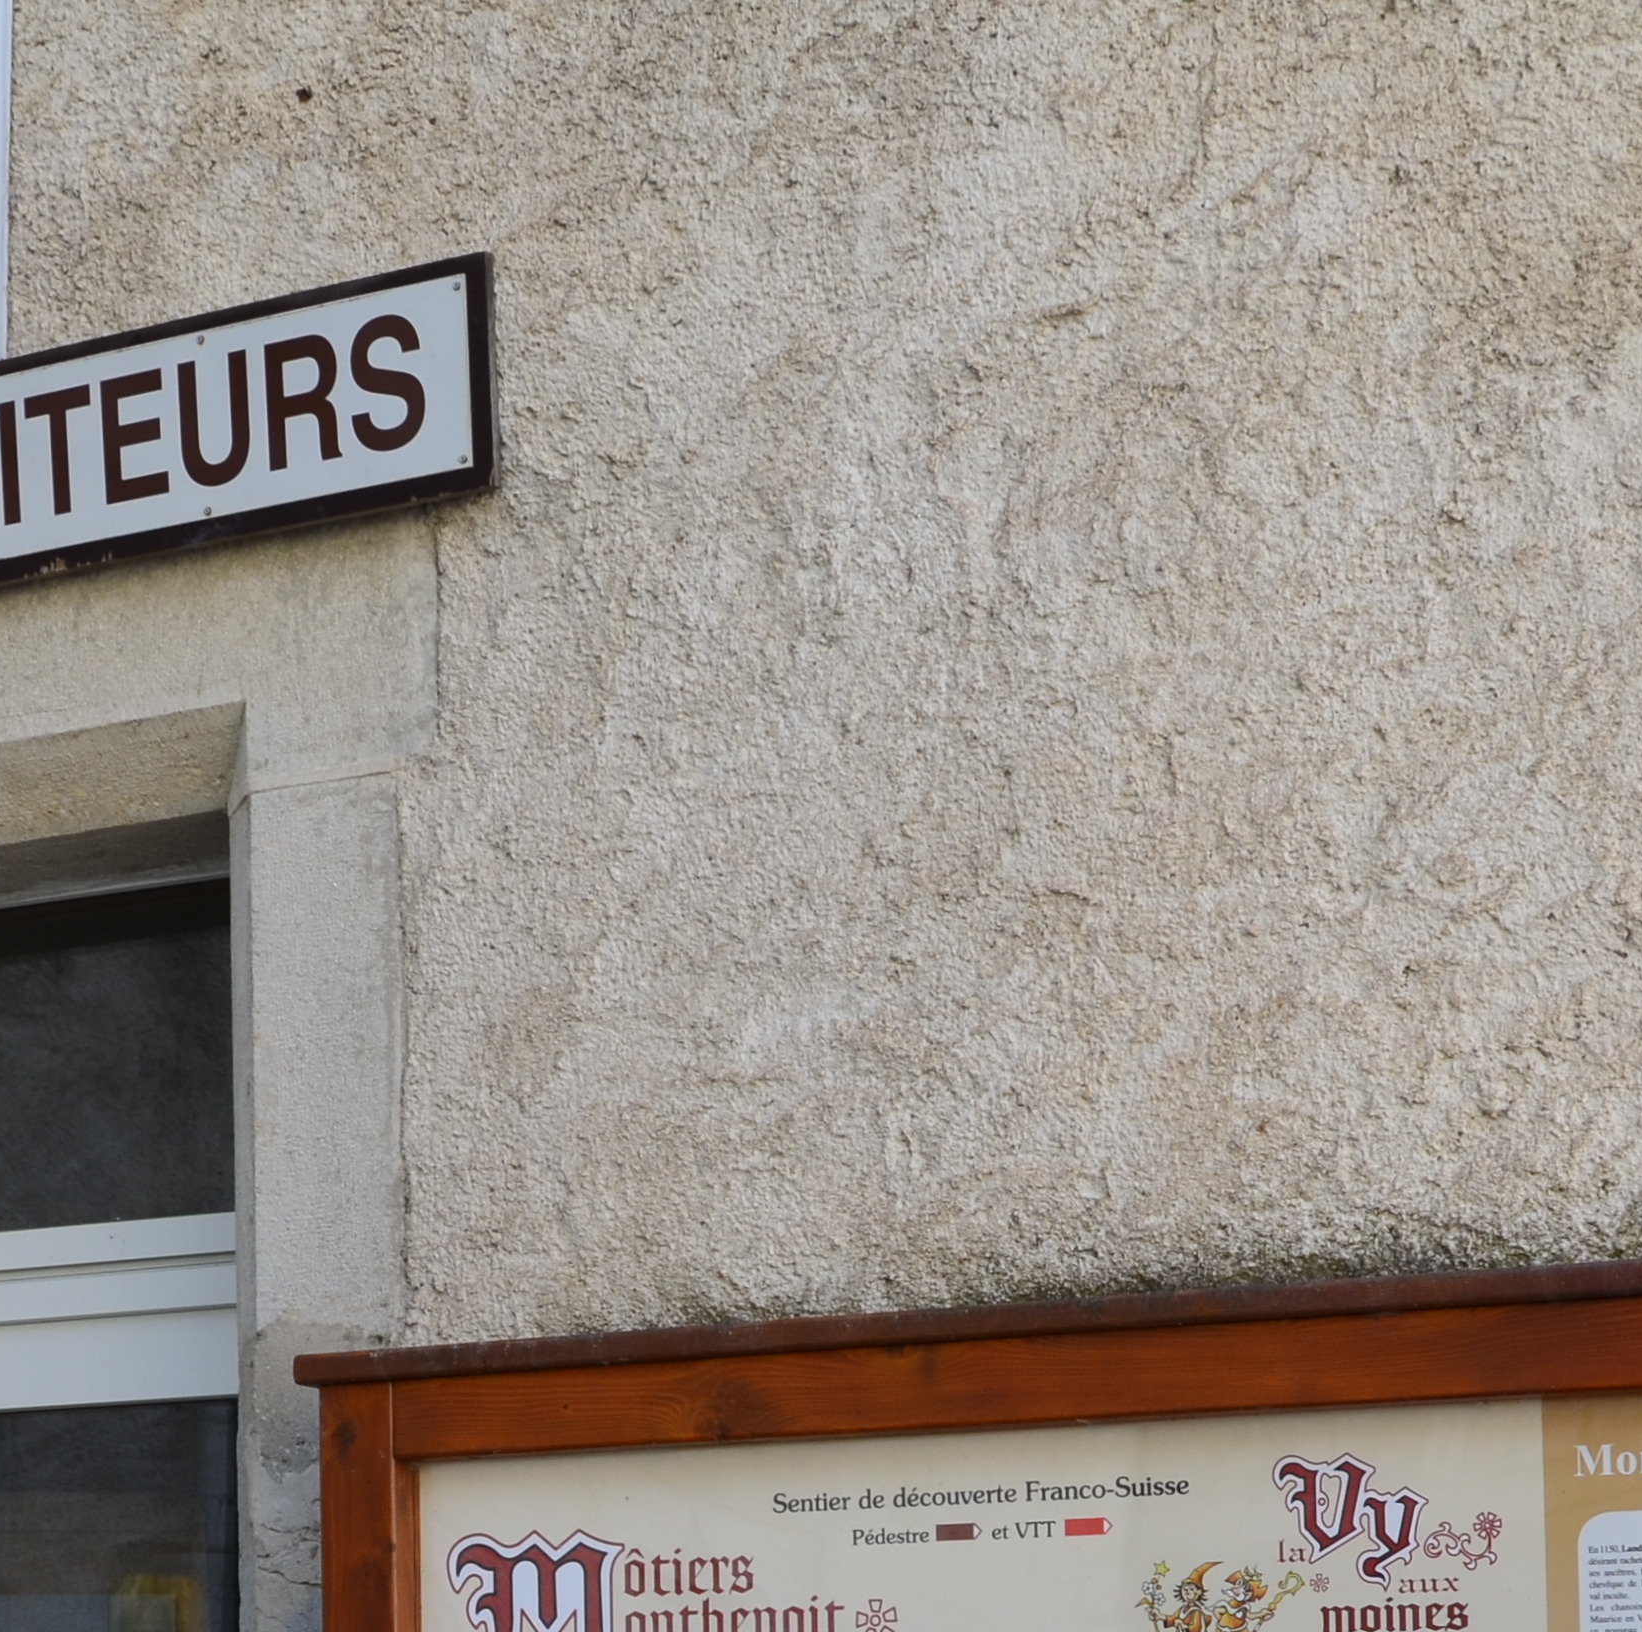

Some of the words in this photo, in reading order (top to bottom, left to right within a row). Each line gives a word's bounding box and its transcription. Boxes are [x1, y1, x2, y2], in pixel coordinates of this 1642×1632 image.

[773, 1493, 850, 1513] Sentier
[859, 1489, 884, 1509] de
[893, 1486, 1016, 1508] découverte
[1026, 1476, 1189, 1501] Franco-Suisse
[853, 1528, 929, 1545] Pédestre
[992, 1526, 1008, 1540] et
[1015, 1521, 1056, 1538] VTT
[1273, 1453, 1428, 1591] Vy
[1279, 1541, 1305, 1563] la
[1399, 1578, 1458, 1593] aux
[1320, 1597, 1468, 1632] moines
